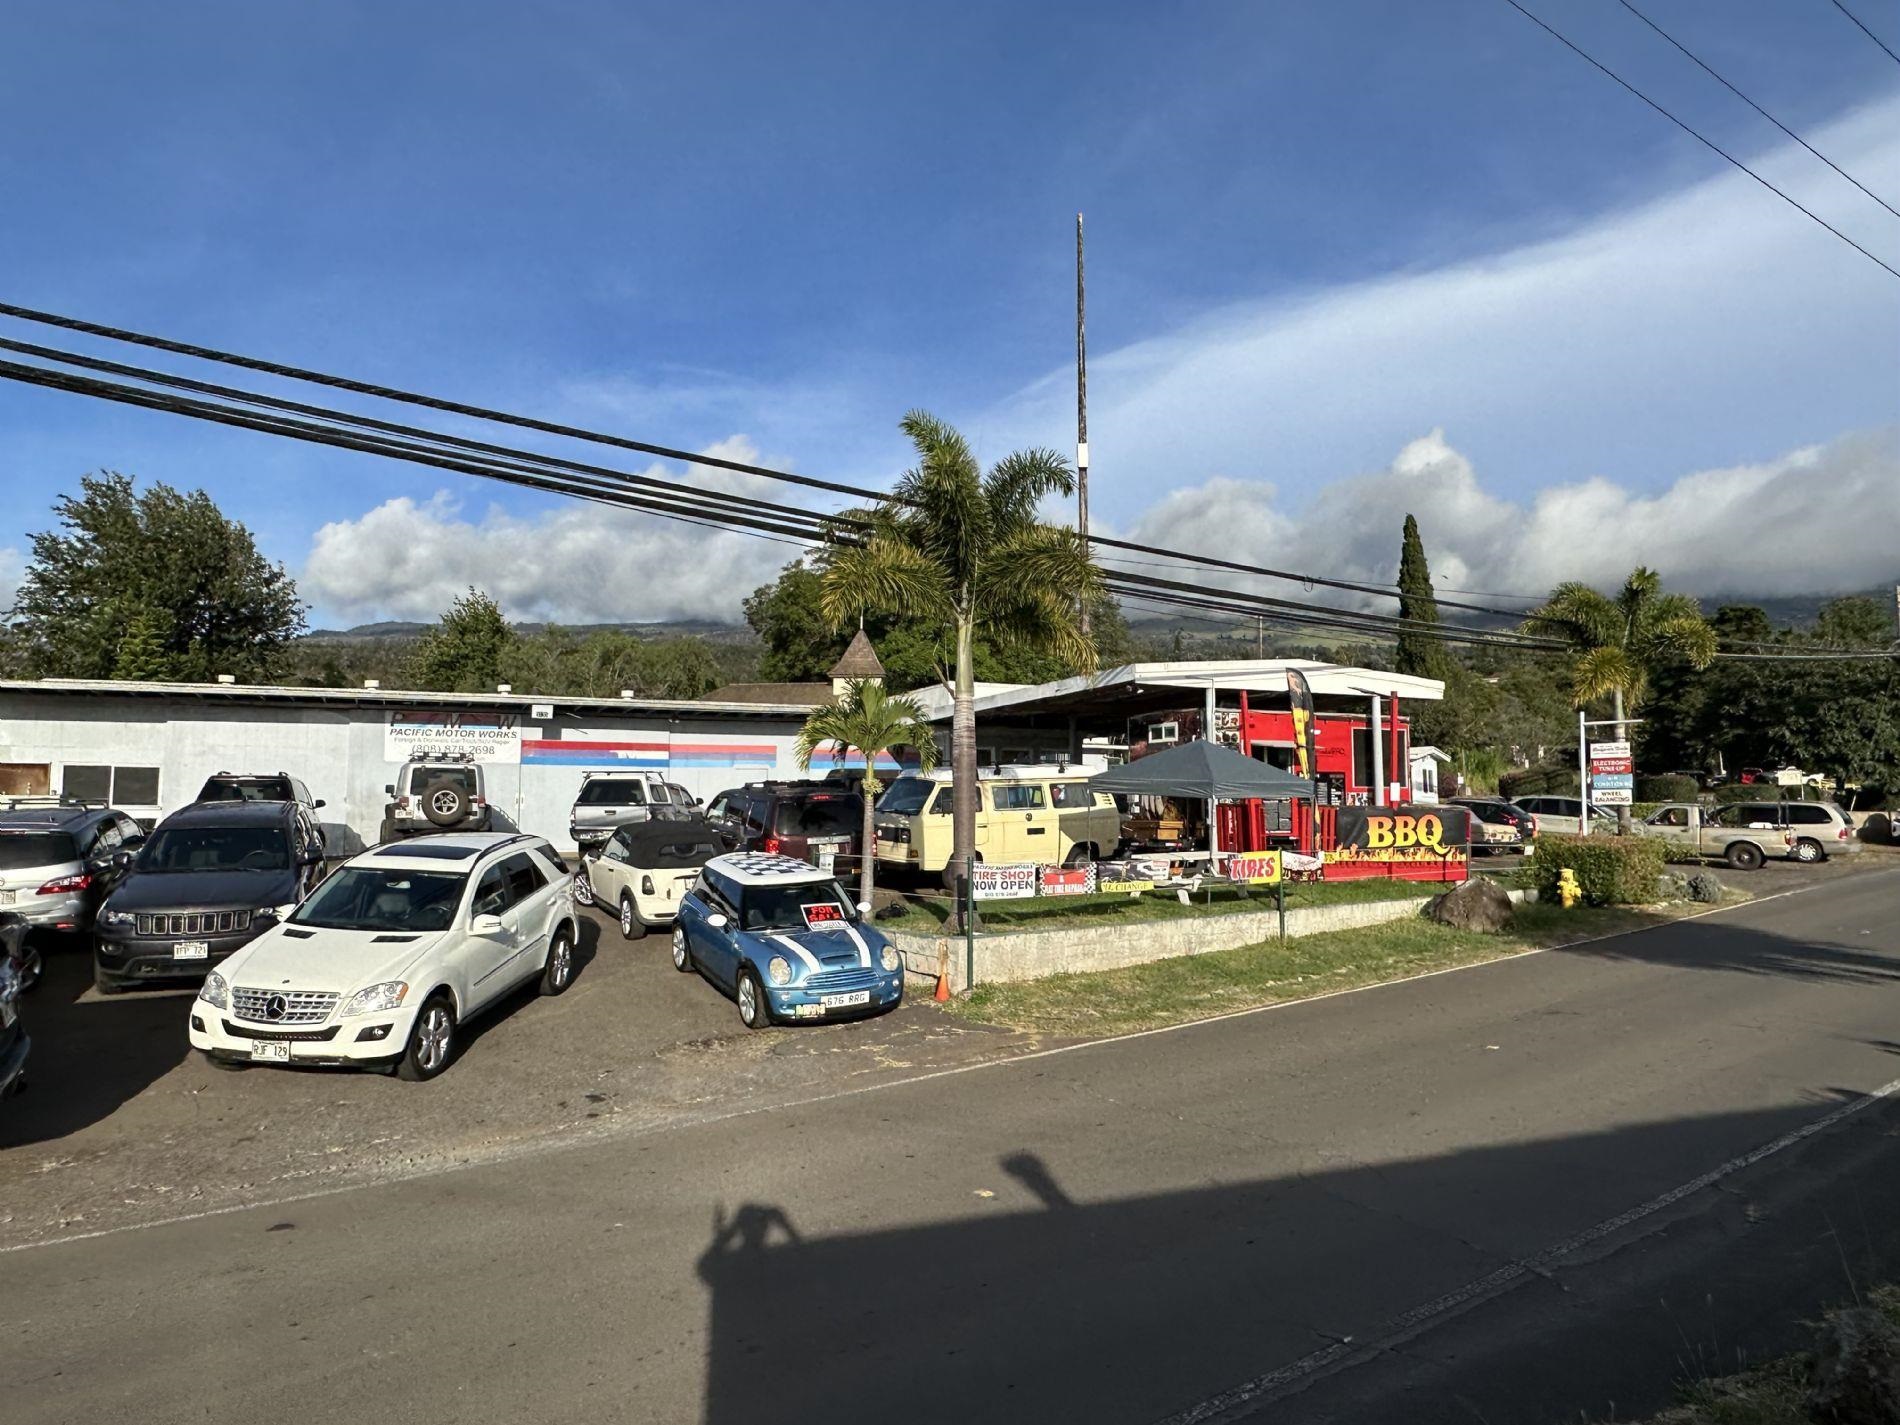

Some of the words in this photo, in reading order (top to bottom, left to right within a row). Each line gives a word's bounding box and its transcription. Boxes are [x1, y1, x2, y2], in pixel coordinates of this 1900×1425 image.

[389, 728, 432, 737] PACIFIC
[435, 729, 476, 738] MOTOR
[479, 730, 518, 739] WORKS
[411, 744, 442, 753] (808)
[1366, 814, 1451, 855] BBQ
[1230, 856, 1276, 880] TIRES
[973, 871, 998, 880] TIRE
[1000, 871, 1033, 880] SHOP
[973, 880, 997, 890] NOW
[1000, 880, 1033, 890] OPEN
[1115, 882, 1148, 891] CHANGE
[811, 906, 834, 914] FOR
[274, 1045, 288, 1057] 129
